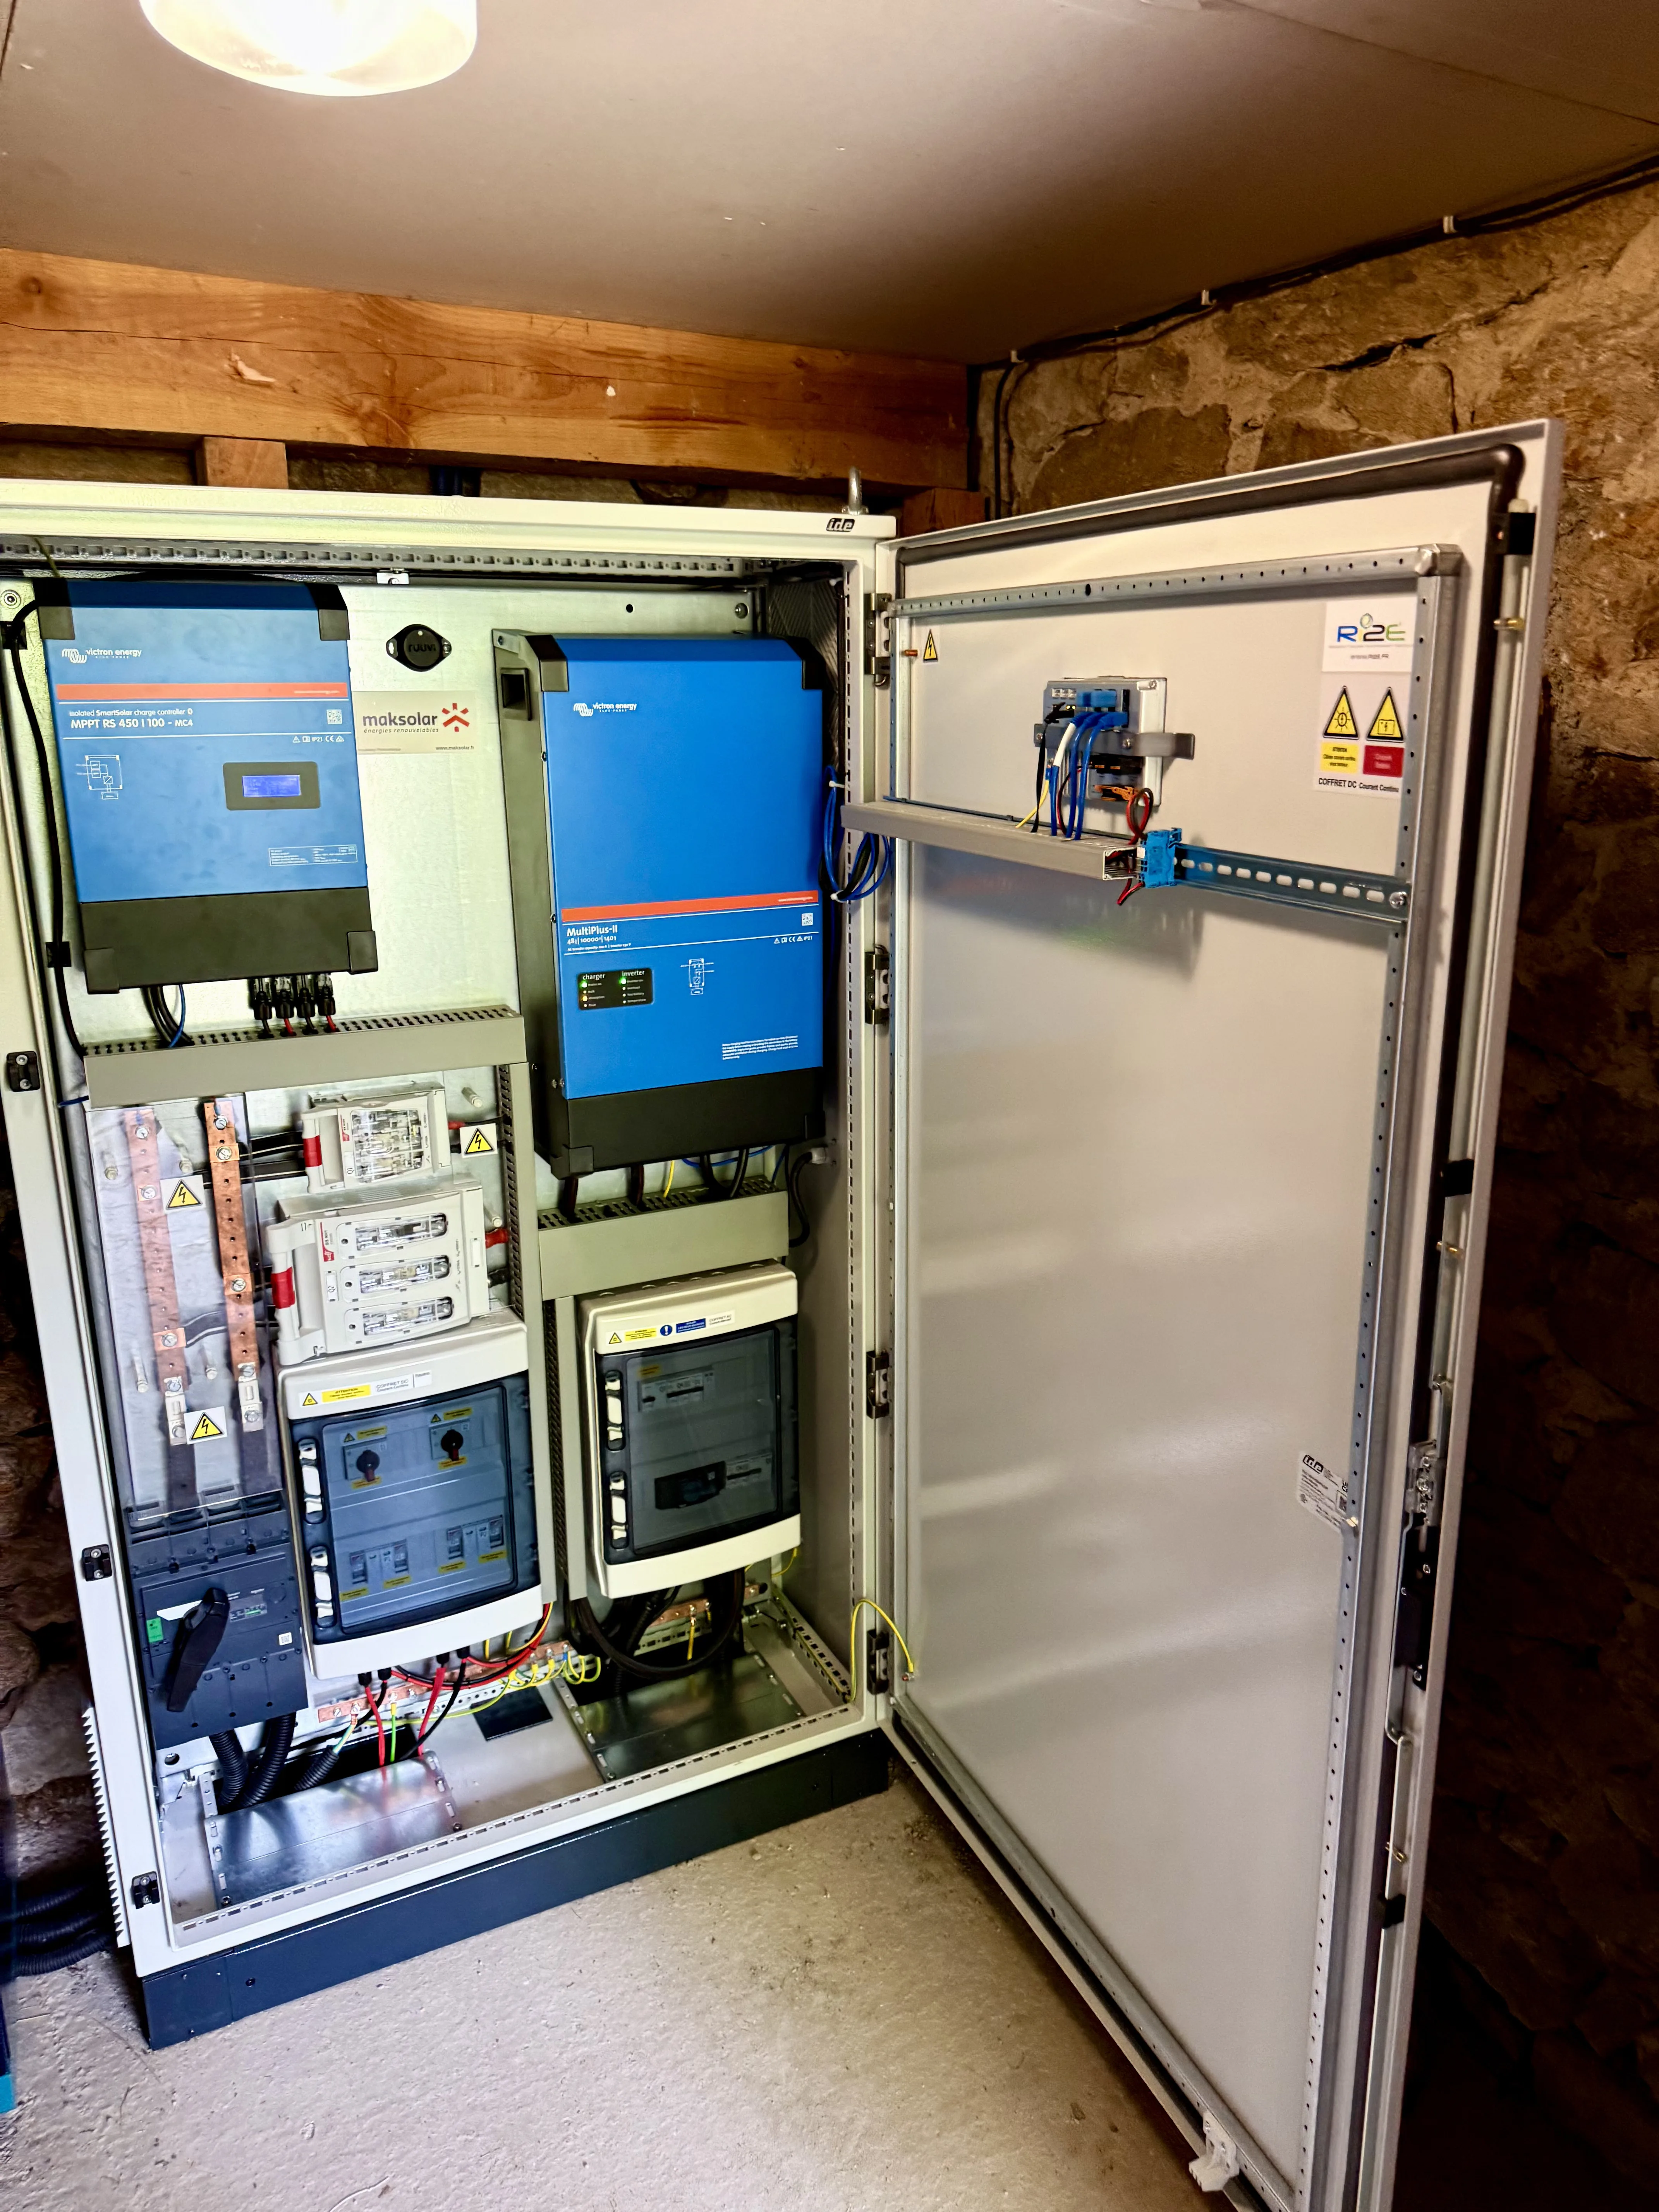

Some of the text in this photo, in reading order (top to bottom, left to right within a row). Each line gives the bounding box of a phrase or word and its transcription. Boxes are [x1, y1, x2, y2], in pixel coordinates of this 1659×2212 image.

[827, 518, 853, 531] ide
[115, 649, 142, 657] energy
[409, 644, 436, 652] ruuvi
[71, 719, 100, 728] MPPT
[103, 719, 116, 728] RS
[118, 718, 139, 728] 450
[147, 718, 165, 727] 100
[362, 712, 438, 726] maksolar
[1318, 778, 1347, 787] COFFRET
[1348, 780, 1357, 788] DC
[567, 924, 618, 937] MultiPlus-II
